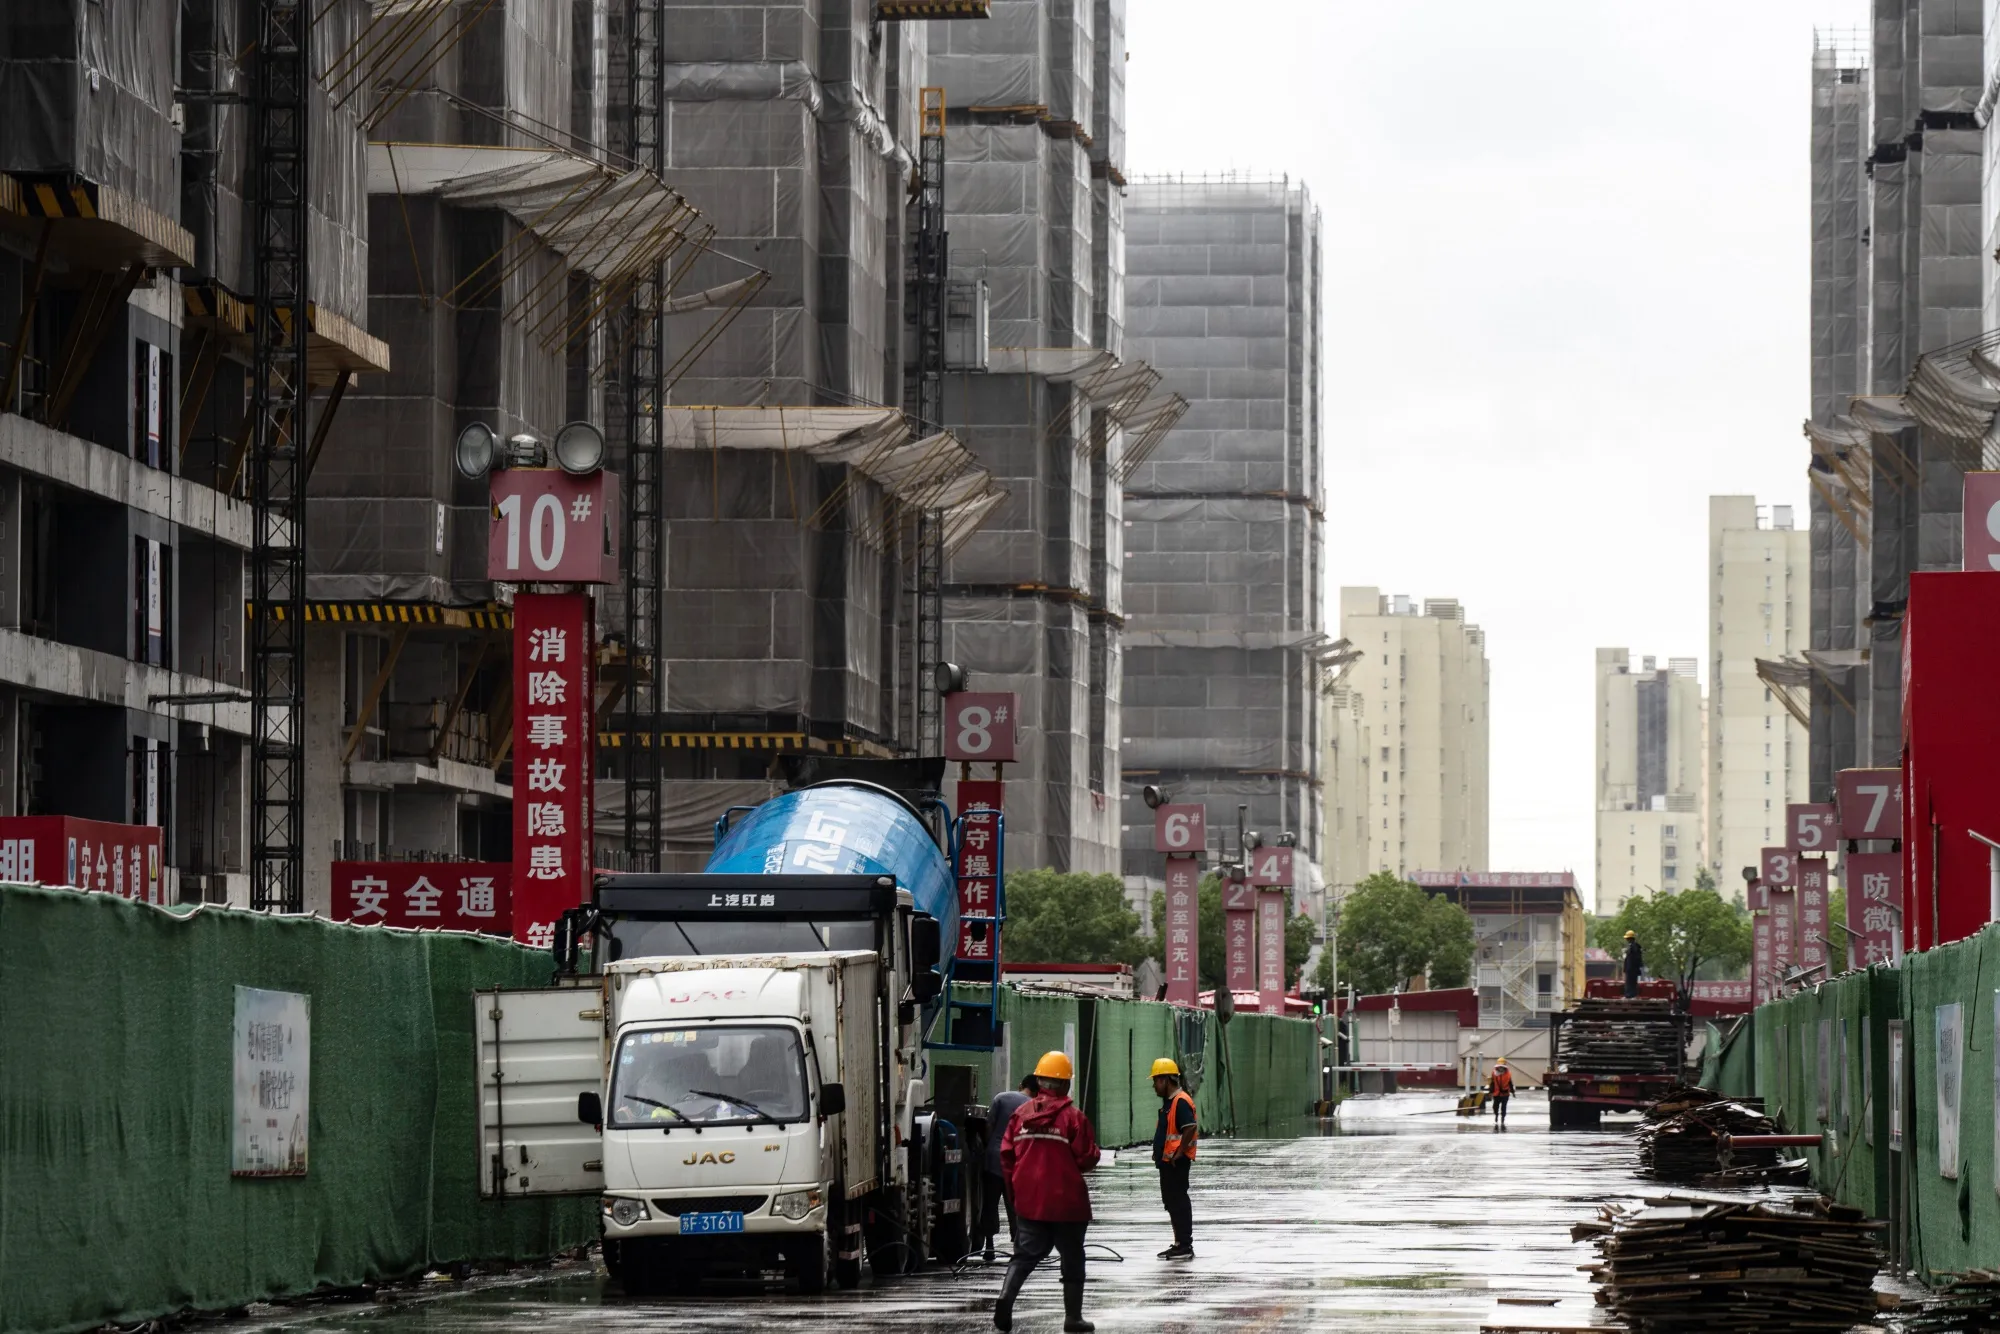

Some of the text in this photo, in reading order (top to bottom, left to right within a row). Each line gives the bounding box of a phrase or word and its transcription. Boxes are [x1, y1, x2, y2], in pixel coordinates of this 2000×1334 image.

[498, 494, 592, 571] 10#
[527, 627, 567, 879] 消除事故隐患
[957, 706, 1008, 754] 8#
[1164, 812, 1200, 847] 6#
[1797, 813, 1834, 848] 5#
[81, 839, 142, 898] 安全通道
[1259, 855, 1290, 882] 4#
[350, 875, 513, 917] 安全通
[708, 893, 775, 907] 上汽红岩
[1172, 872, 1189, 981] 生命至高无上
[1232, 919, 1246, 979] 安全生产
[1263, 903, 1279, 991] 同创安全工地
[683, 1150, 736, 1166] JAC
